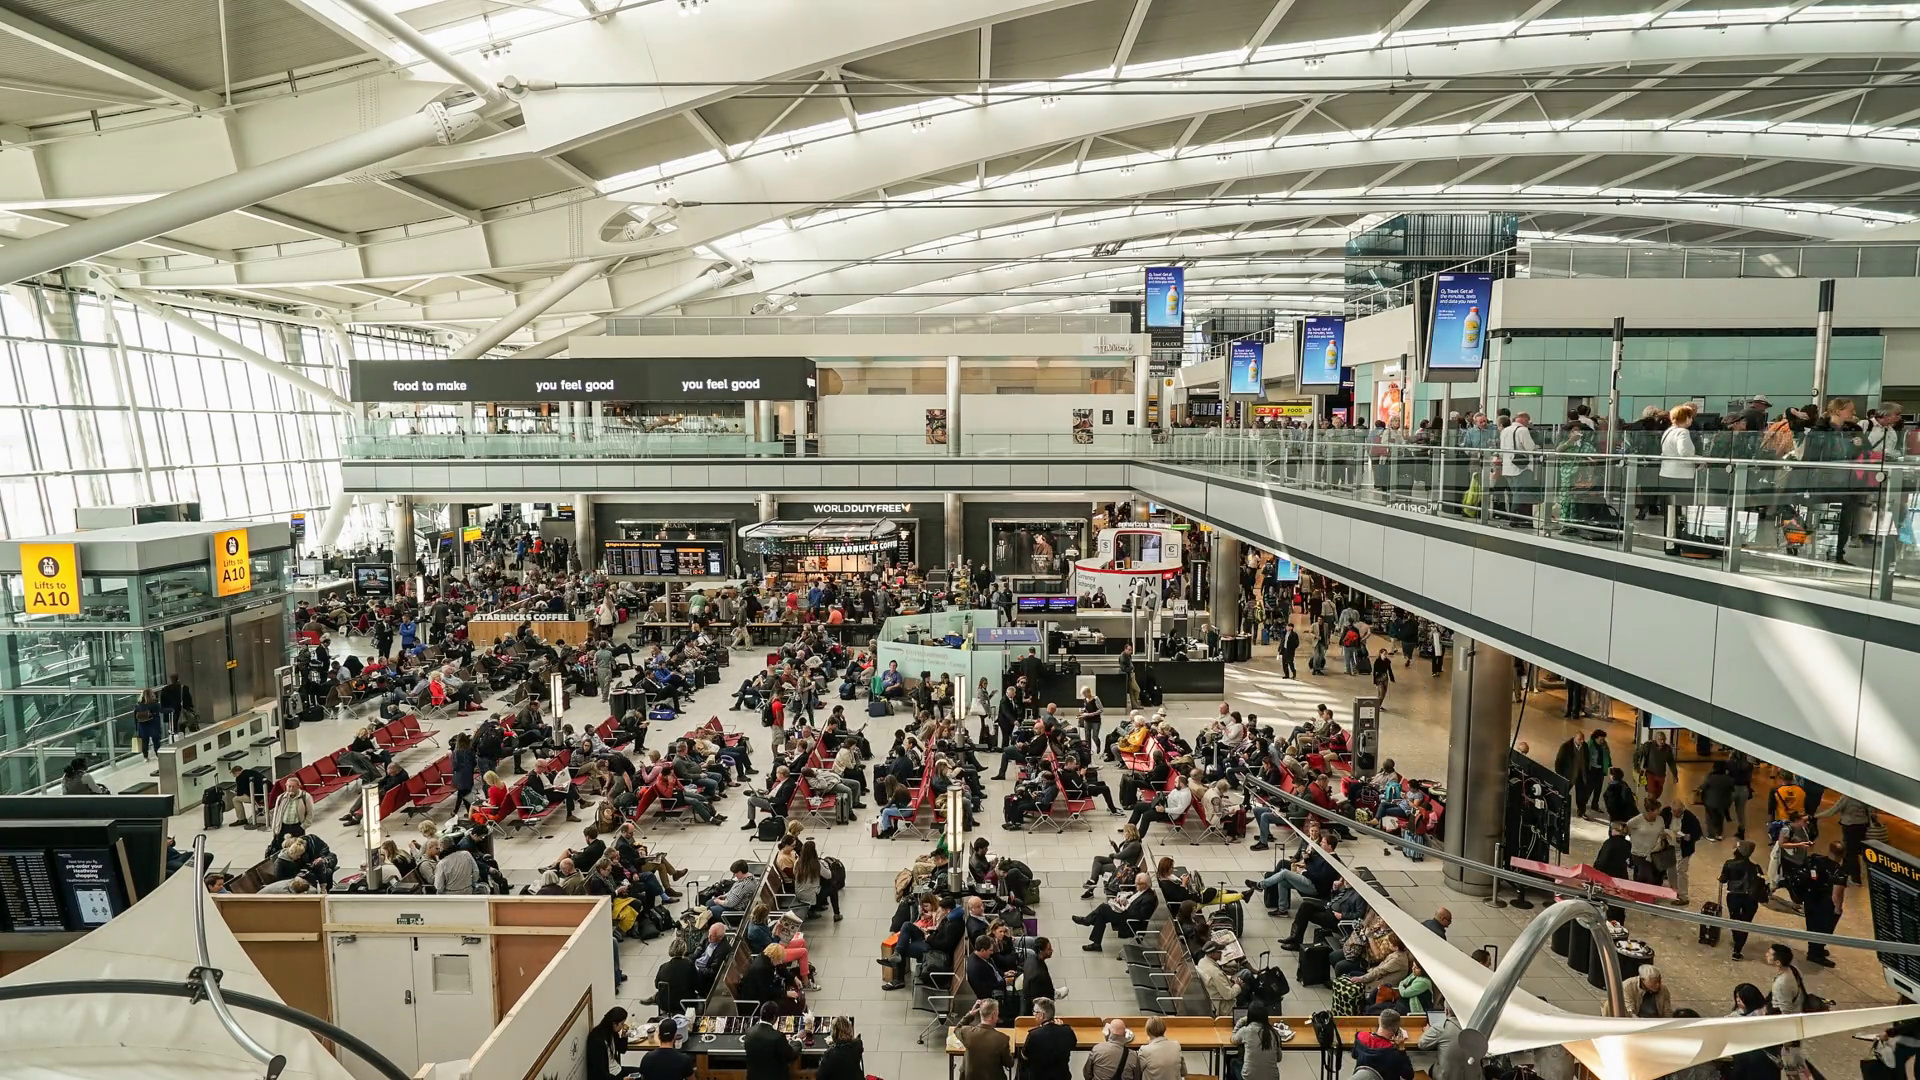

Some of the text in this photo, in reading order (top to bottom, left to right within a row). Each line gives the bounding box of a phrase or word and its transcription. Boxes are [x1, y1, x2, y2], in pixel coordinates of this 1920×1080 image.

[1094, 336, 1134, 354] Harrods
[393, 381, 467, 391] food to make
[536, 379, 614, 393] you feel good
[682, 378, 760, 392] you feel good
[828, 543, 879, 554] STARBUCKS
[223, 559, 236, 568] Lifts
[222, 566, 245, 583] A10
[34, 581, 67, 590] Lifts to
[33, 591, 70, 606] A10
[474, 613, 569, 621] STARBUCKS COFFEE
[1878, 854, 1910, 877] Flight
